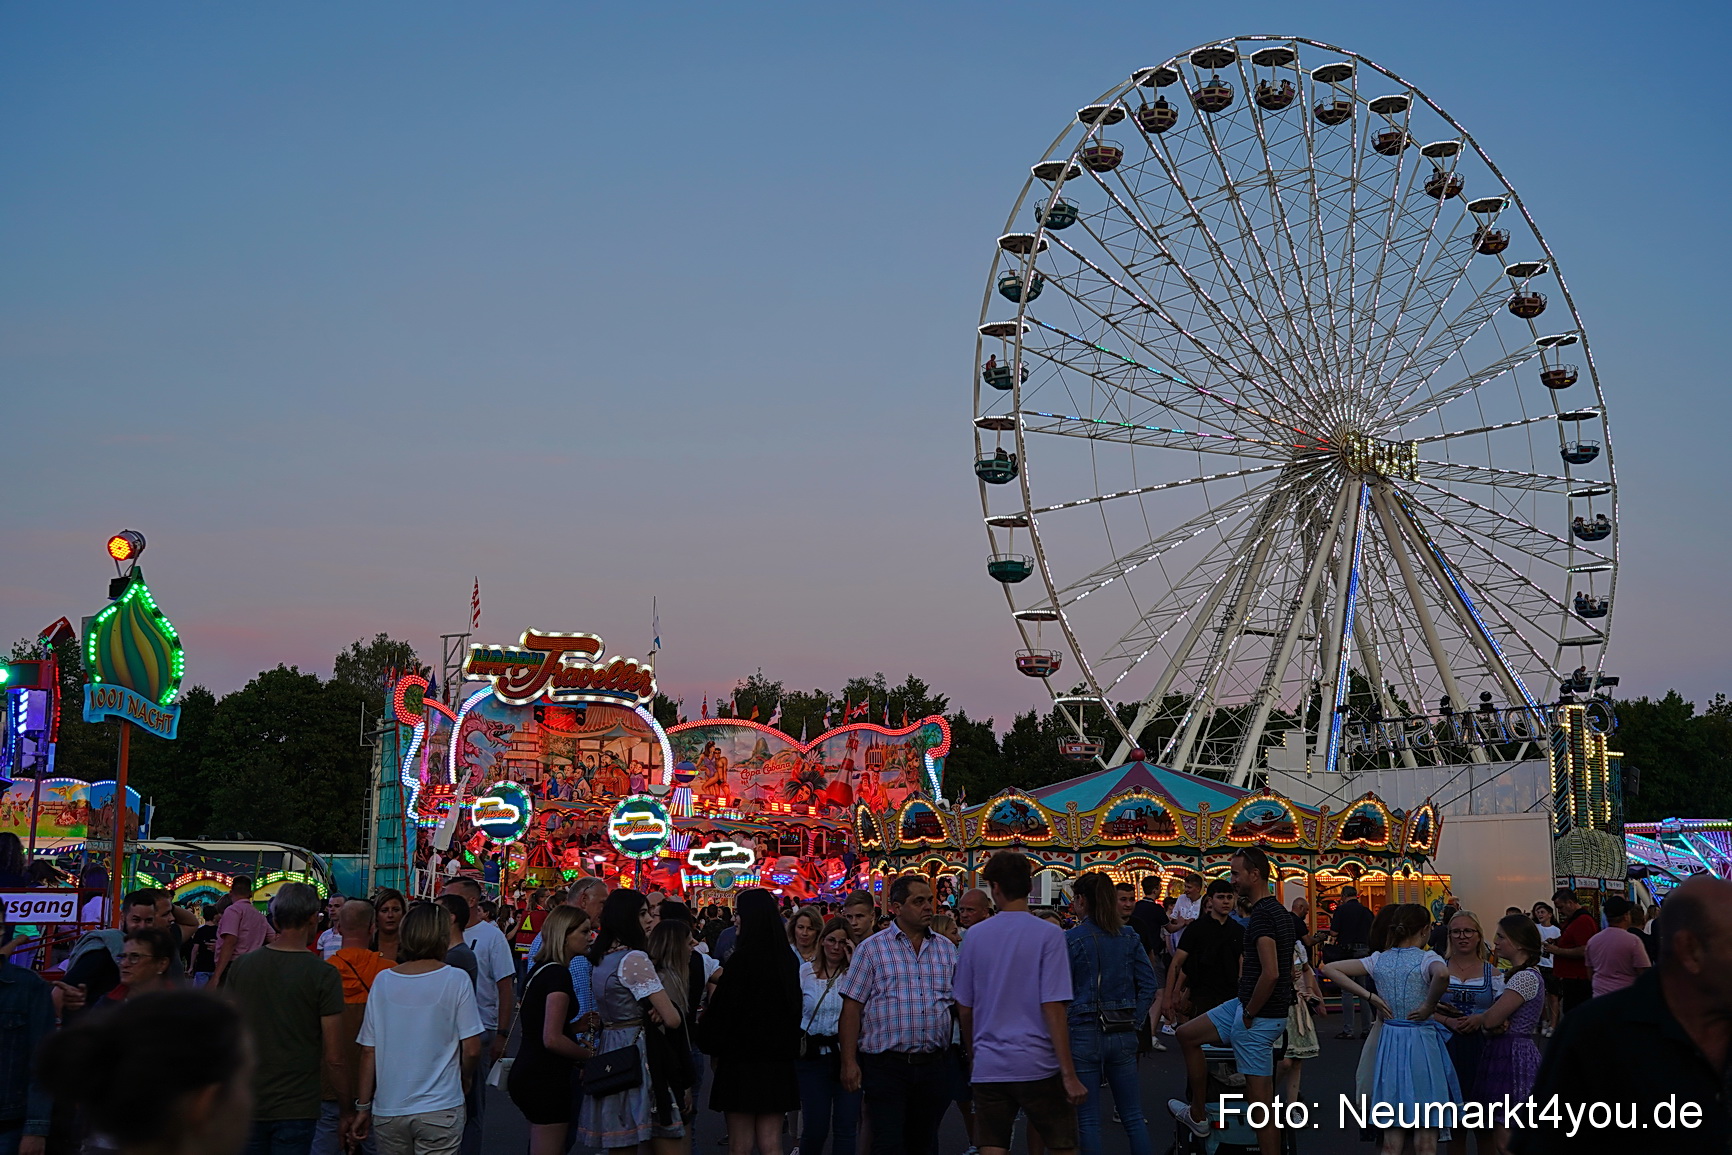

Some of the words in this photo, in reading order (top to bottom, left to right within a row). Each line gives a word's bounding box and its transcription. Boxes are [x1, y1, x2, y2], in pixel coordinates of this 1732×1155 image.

[495, 632, 653, 699] Traveller
[90, 687, 124, 711] 1001
[127, 694, 175, 734] NACHT
[740, 768, 761, 781] Copa
[763, 762, 791, 775] Cabana
